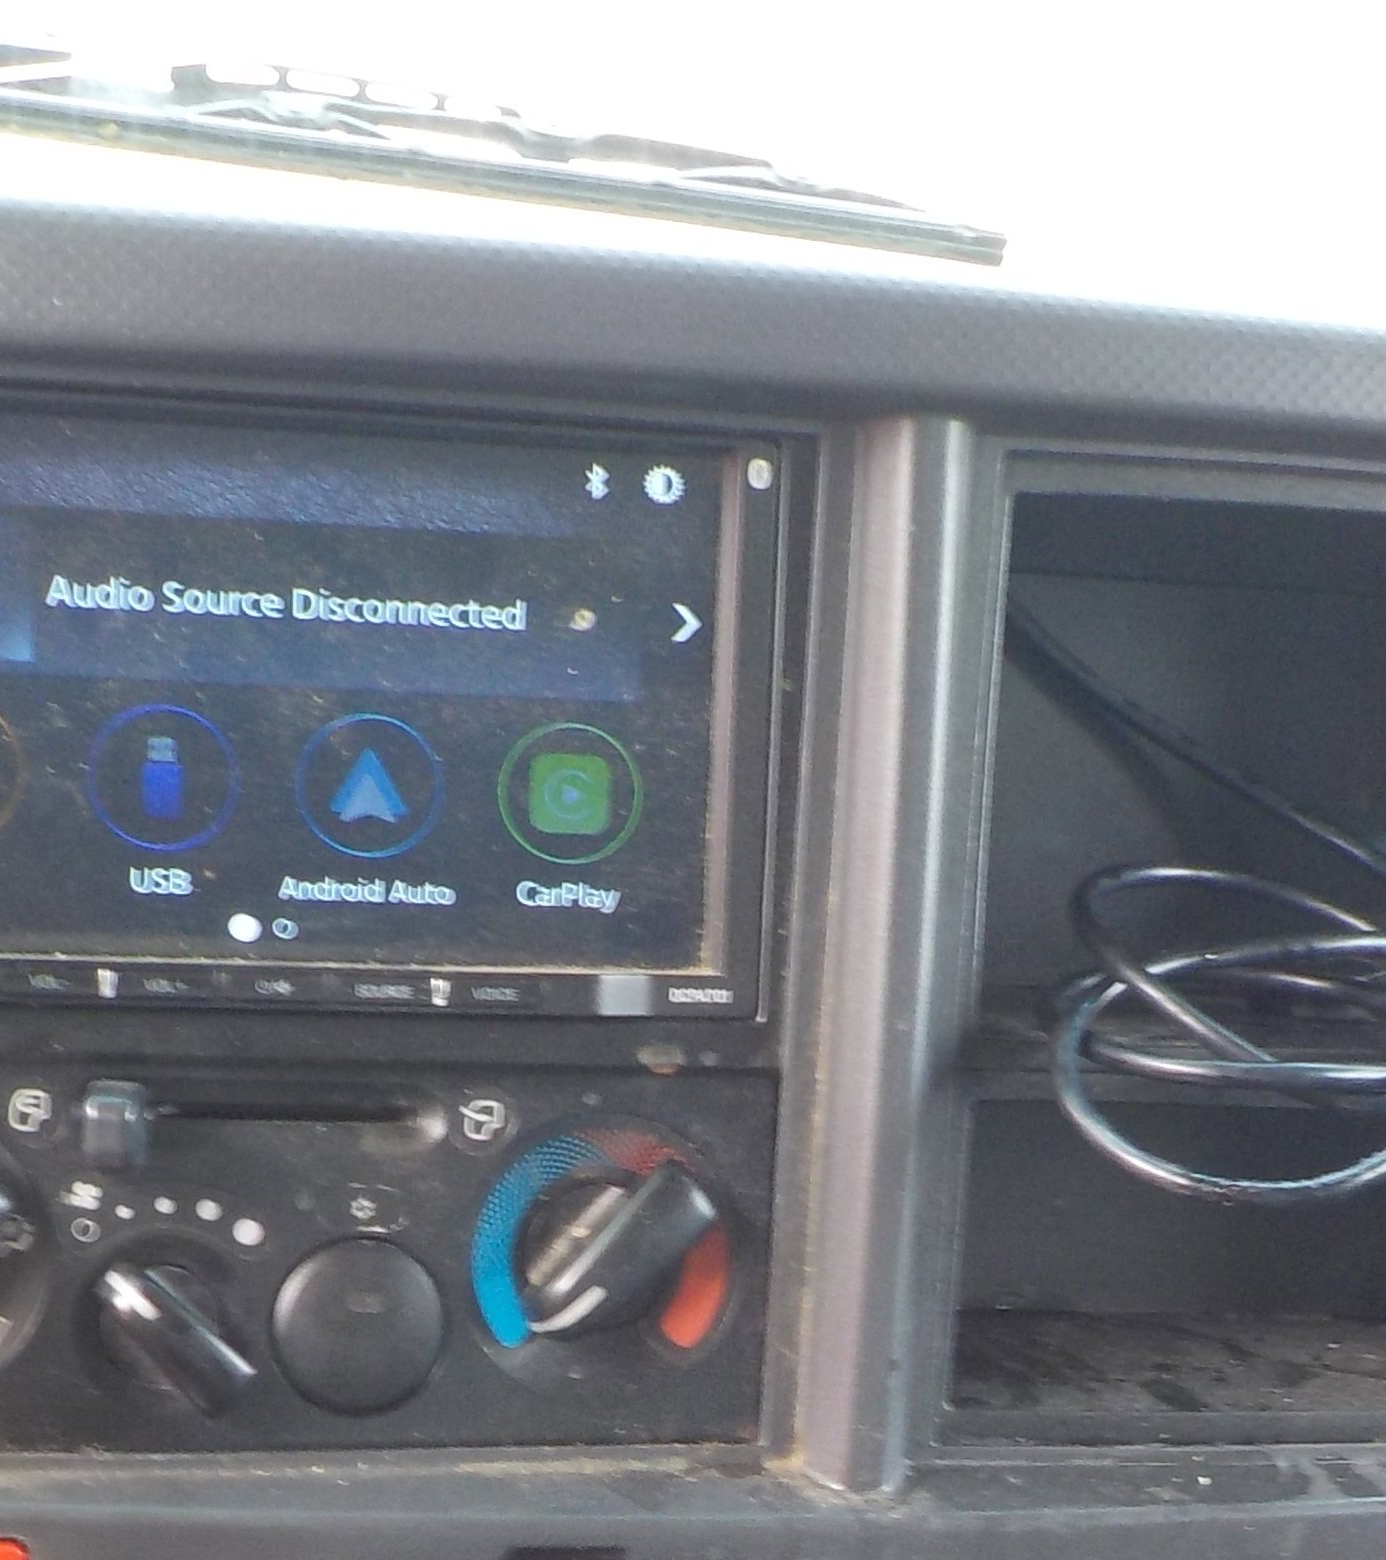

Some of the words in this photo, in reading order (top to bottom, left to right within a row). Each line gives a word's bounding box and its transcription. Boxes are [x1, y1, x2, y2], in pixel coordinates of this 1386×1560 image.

[45, 574, 155, 612] Audio
[162, 580, 286, 618] Source
[292, 587, 528, 631] Disconnected
[129, 865, 194, 896] USB
[277, 875, 387, 904] Android
[387, 878, 458, 906] Auto
[515, 879, 622, 915] CarPlay
